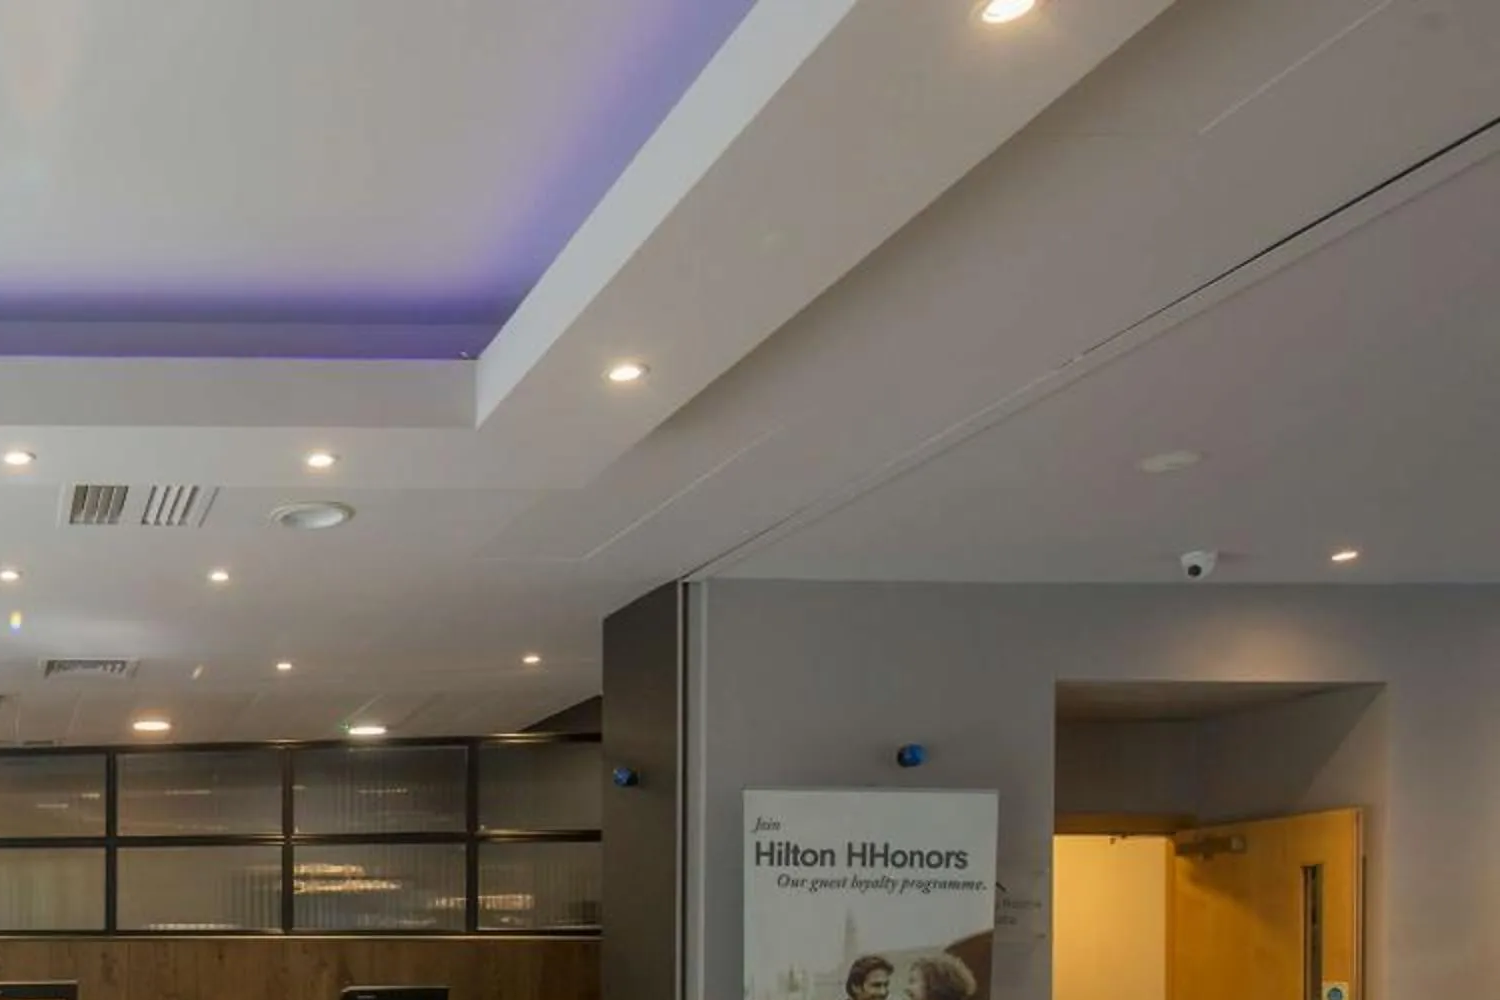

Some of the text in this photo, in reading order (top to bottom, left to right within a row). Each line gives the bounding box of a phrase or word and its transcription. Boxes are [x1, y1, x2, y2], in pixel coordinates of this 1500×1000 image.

[751, 815, 781, 835] Join
[755, 841, 969, 870] Hilton HHonors
[777, 873, 988, 896] Our guest loyalty programme.
